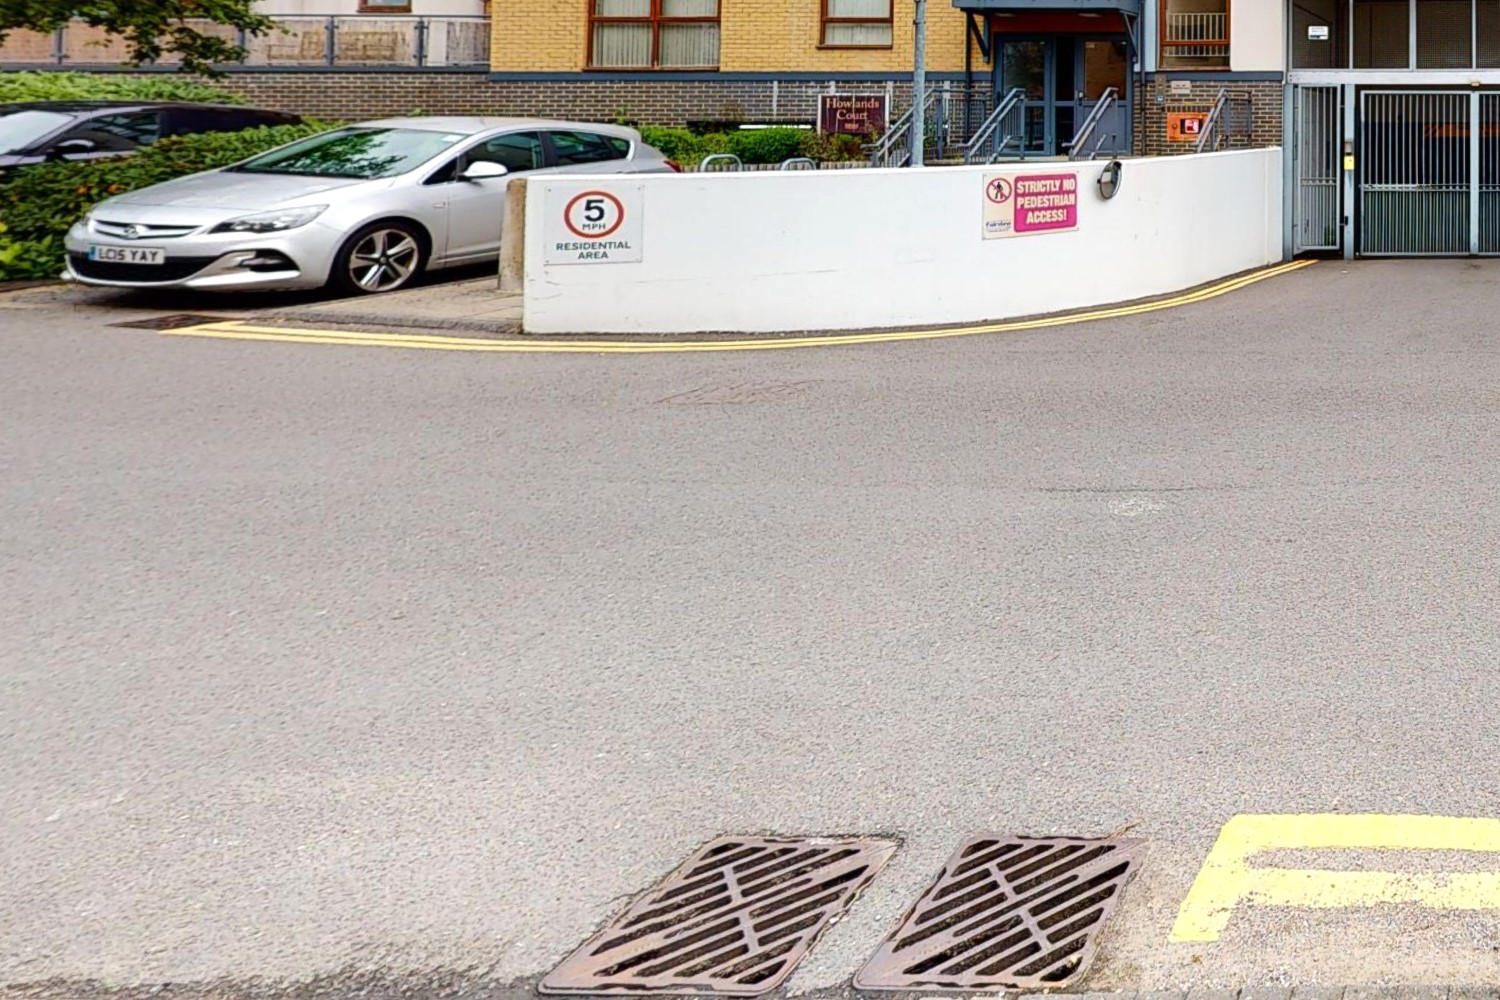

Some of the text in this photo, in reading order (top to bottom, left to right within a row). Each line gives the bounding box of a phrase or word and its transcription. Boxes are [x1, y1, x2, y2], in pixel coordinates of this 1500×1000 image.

[827, 98, 880, 109] Howlands
[837, 109, 869, 120] Court
[1016, 178, 1076, 194] STRICTLY NO
[1016, 193, 1076, 209] PEDESTRIAN
[584, 199, 605, 222] 5
[1025, 209, 1068, 225] ACCESS!
[582, 222, 607, 230] MPH
[556, 241, 631, 251] RESIDENTIAL
[129, 249, 158, 262] YAY
[577, 251, 609, 260] AREA
